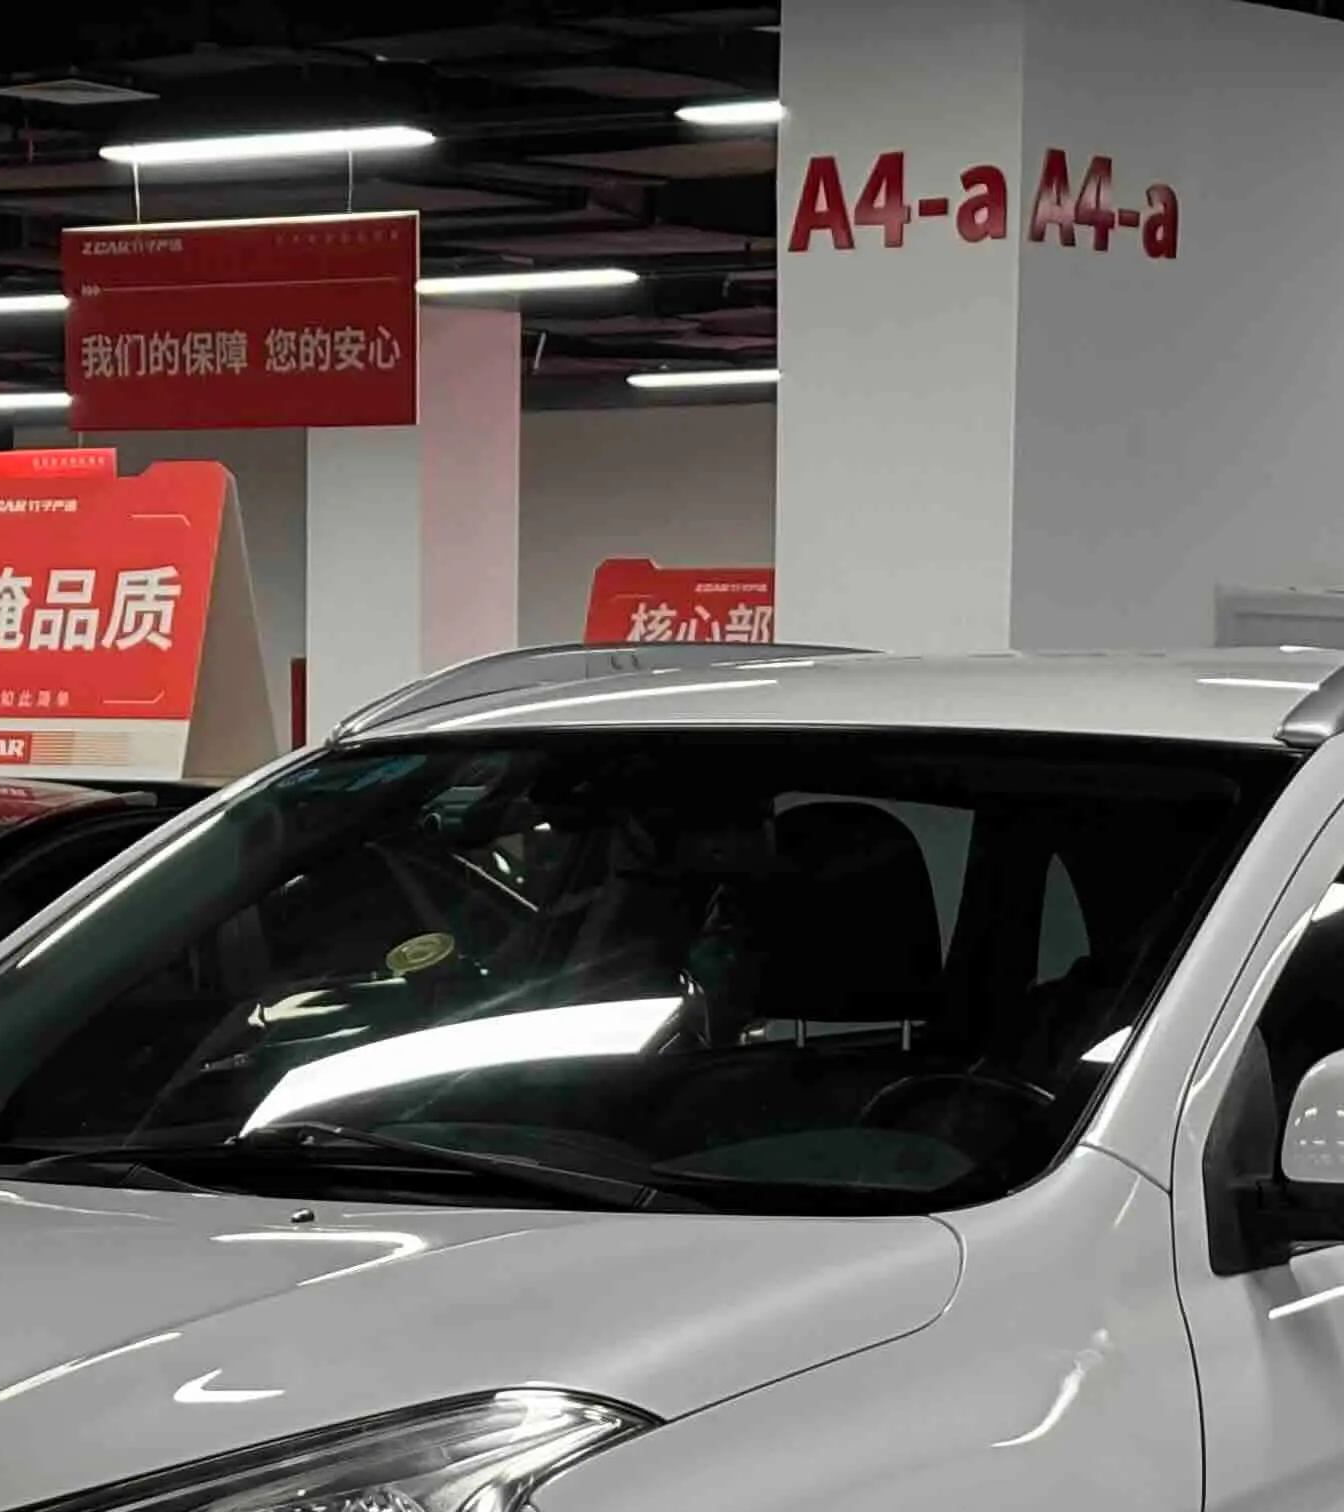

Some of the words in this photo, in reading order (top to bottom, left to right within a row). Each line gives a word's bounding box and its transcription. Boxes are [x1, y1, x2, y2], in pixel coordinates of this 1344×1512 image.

[787, 151, 1008, 253] A4-a
[1028, 148, 1179, 259] A4-a
[81, 329, 249, 379] 我们的保障
[264, 325, 402, 373] 您的安心
[625, 602, 773, 643] 核心部
